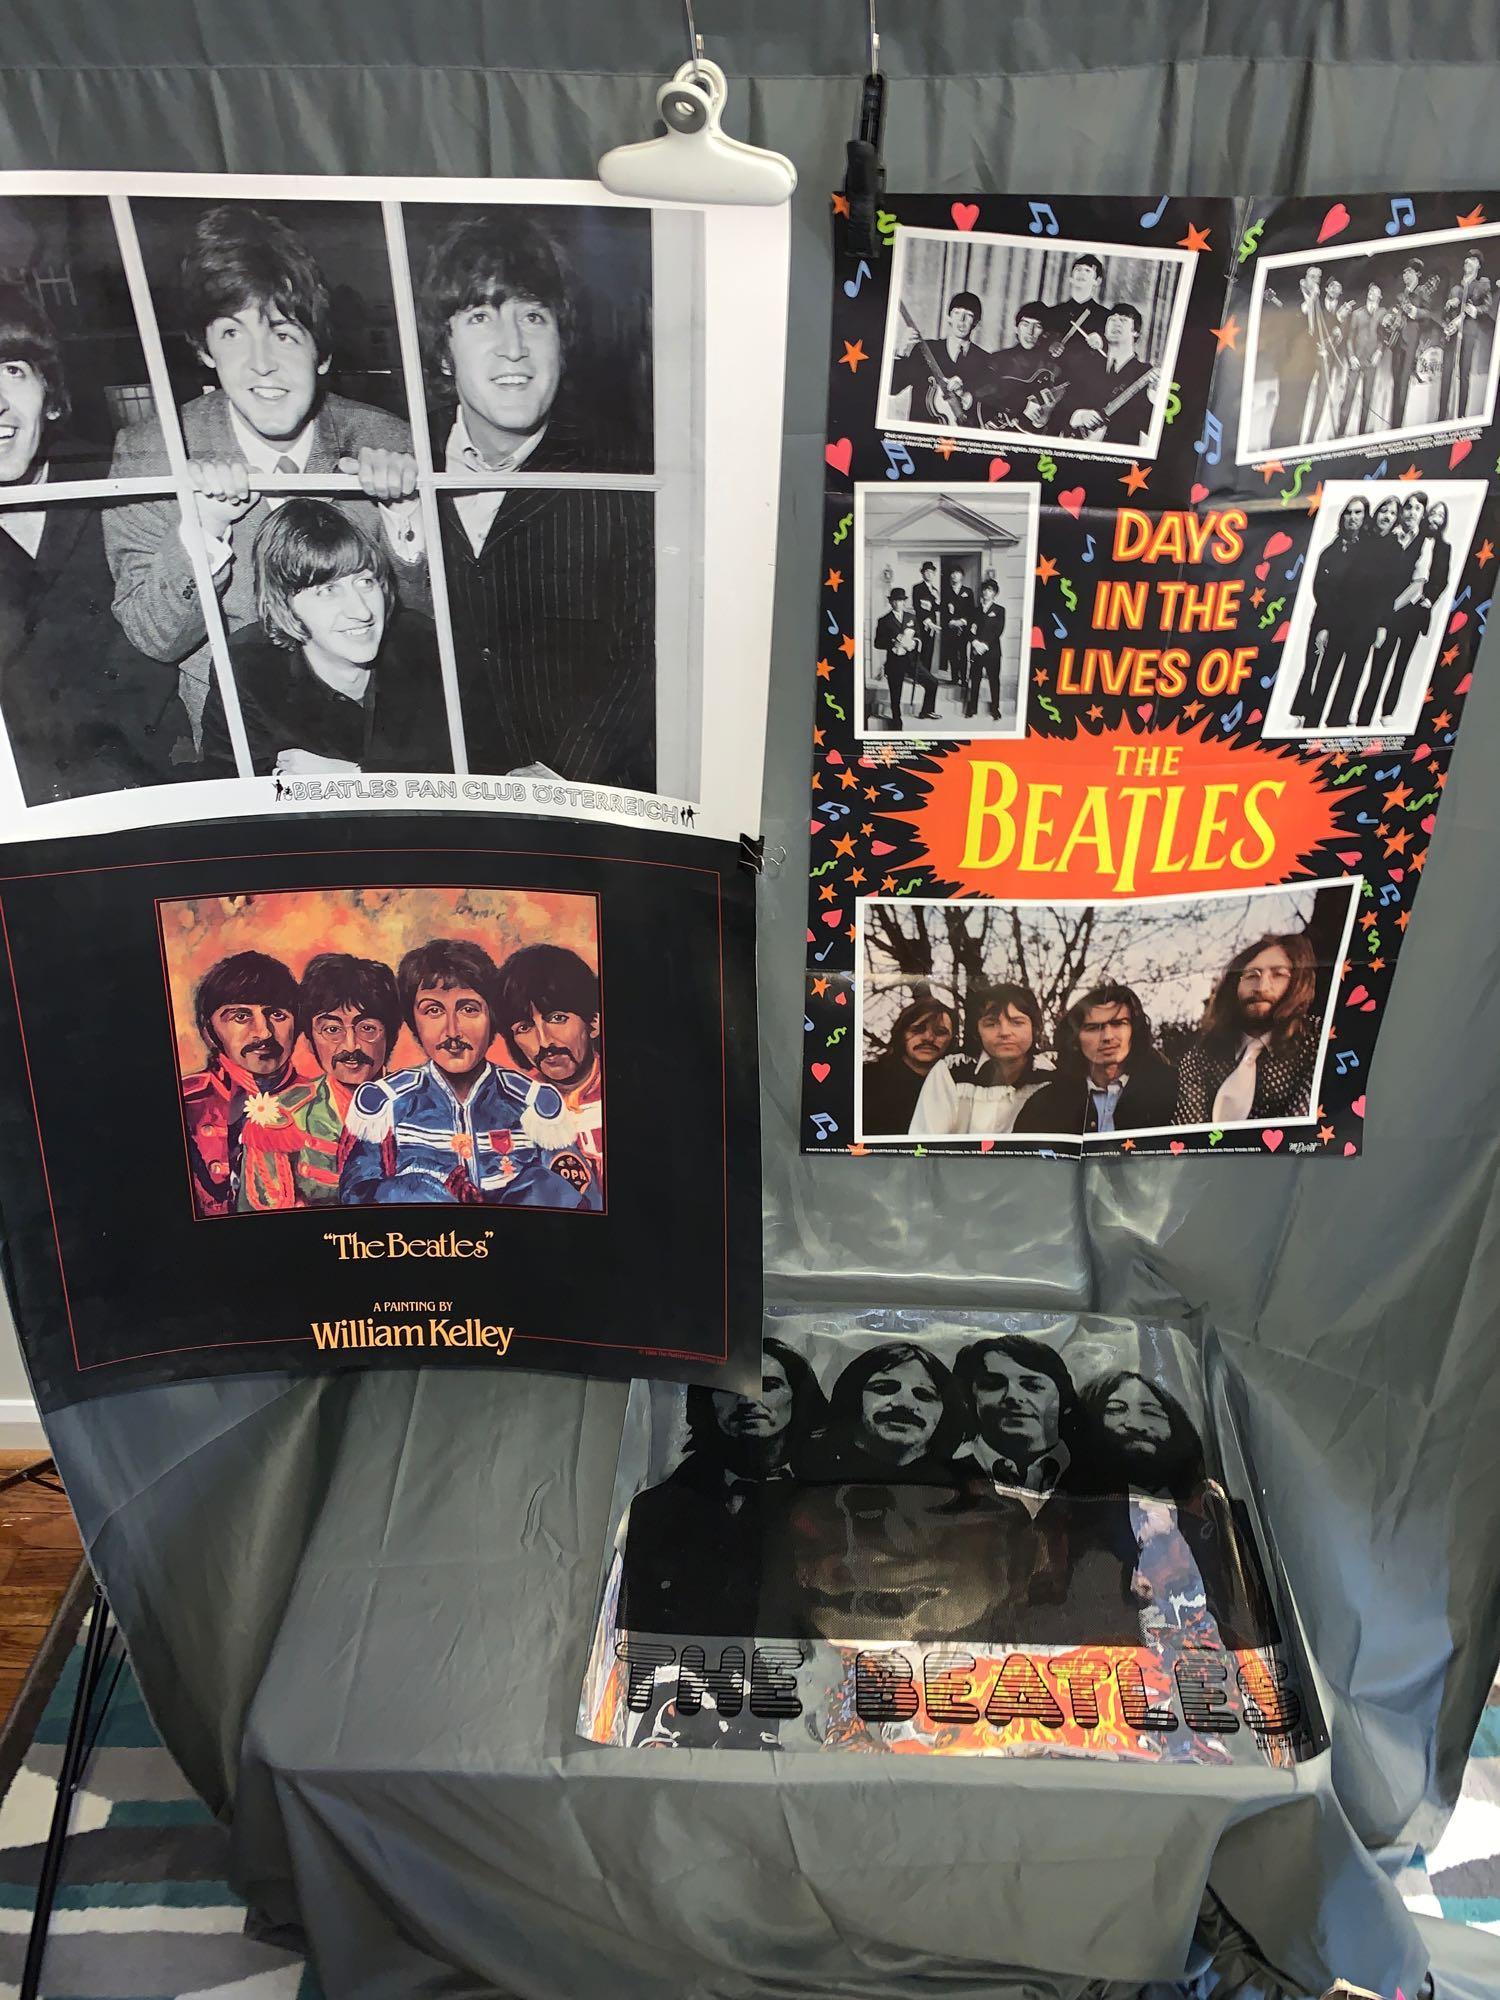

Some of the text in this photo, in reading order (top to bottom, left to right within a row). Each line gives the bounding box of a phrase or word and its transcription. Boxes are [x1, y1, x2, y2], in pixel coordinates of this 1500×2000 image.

[1112, 507, 1248, 564] DAYS
[1091, 580, 1245, 633] IN THE
[1056, 647, 1259, 697] LIVES OF
[1112, 746, 1184, 777] THE
[292, 780, 679, 825] BEATLES FAN CLUB ÖSTERREICH
[957, 759, 1287, 892] BEATLES
[373, 1301, 453, 1312] A PAINTING BY
[310, 1318, 515, 1356] William Kelley
[614, 1641, 1300, 1734] THE BEATLES
